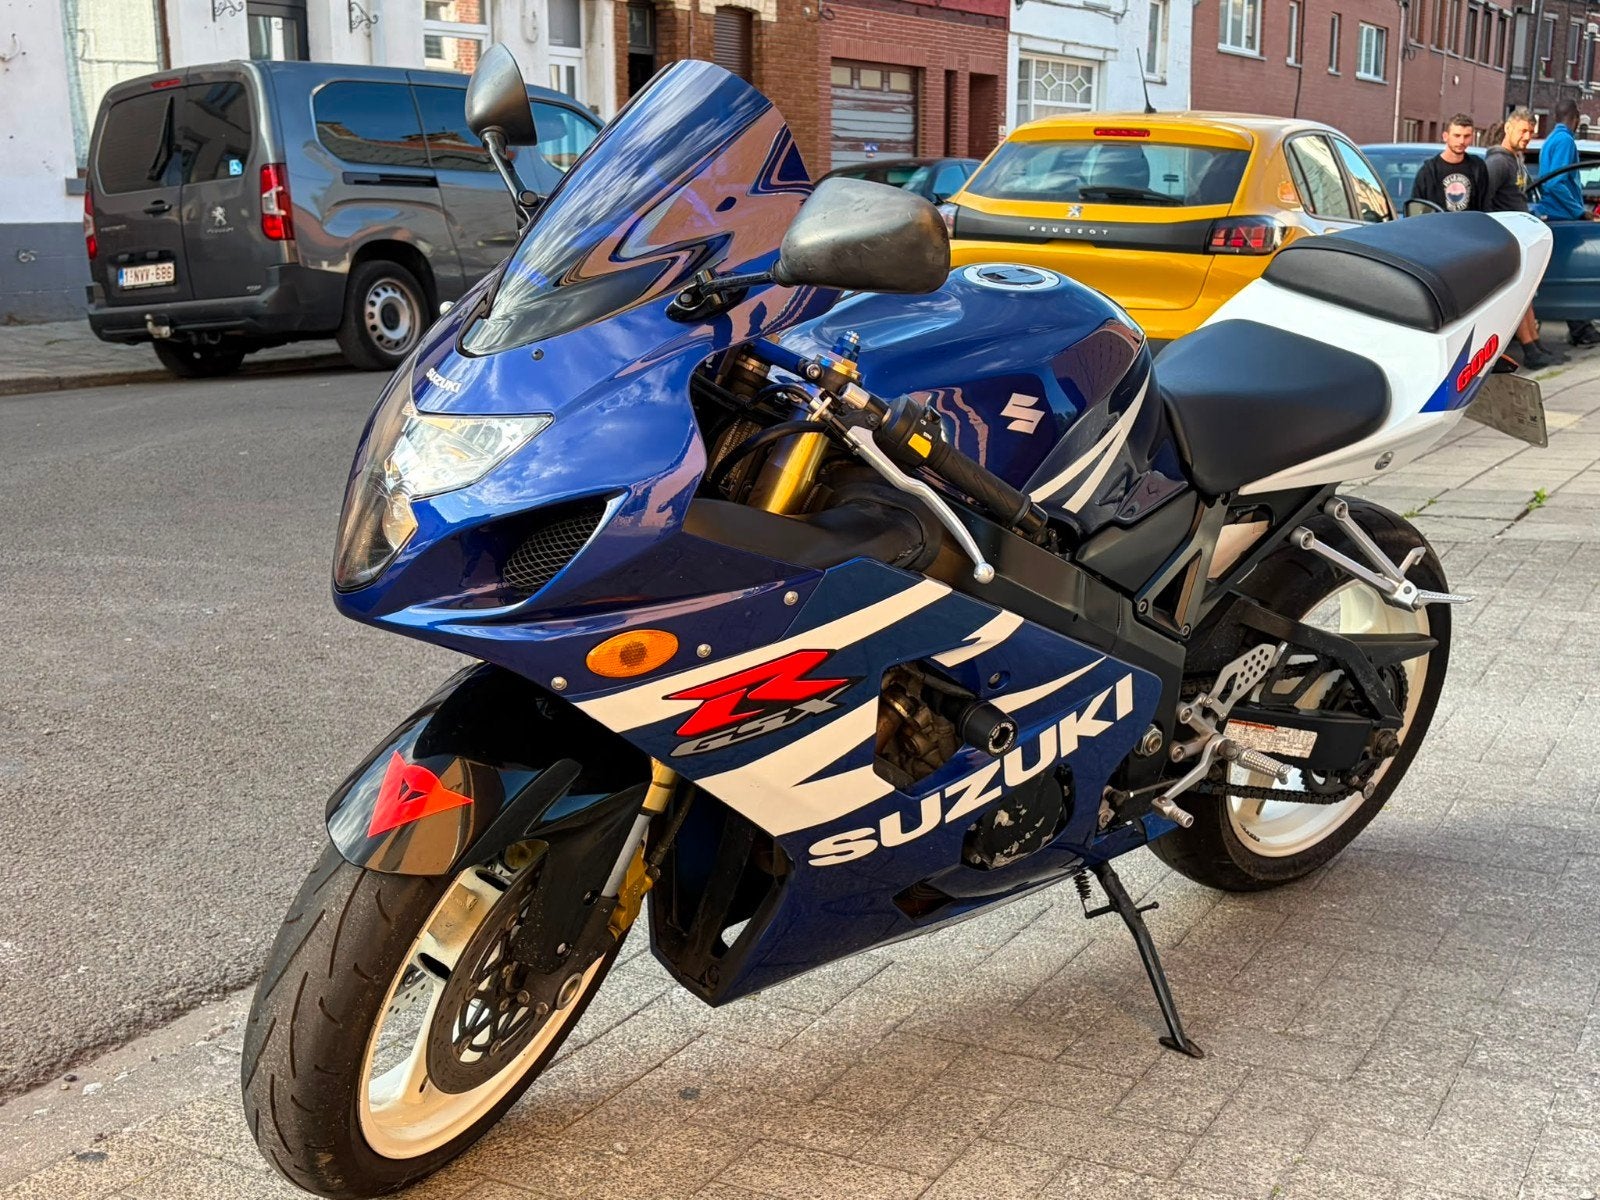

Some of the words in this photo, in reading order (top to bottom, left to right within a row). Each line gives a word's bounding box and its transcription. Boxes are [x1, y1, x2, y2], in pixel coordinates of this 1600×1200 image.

[1028, 225, 1109, 236] PEUGEOT
[426, 367, 462, 393] SUZUKI
[1457, 333, 1499, 393] 600
[808, 672, 1134, 867] SUZUKI
